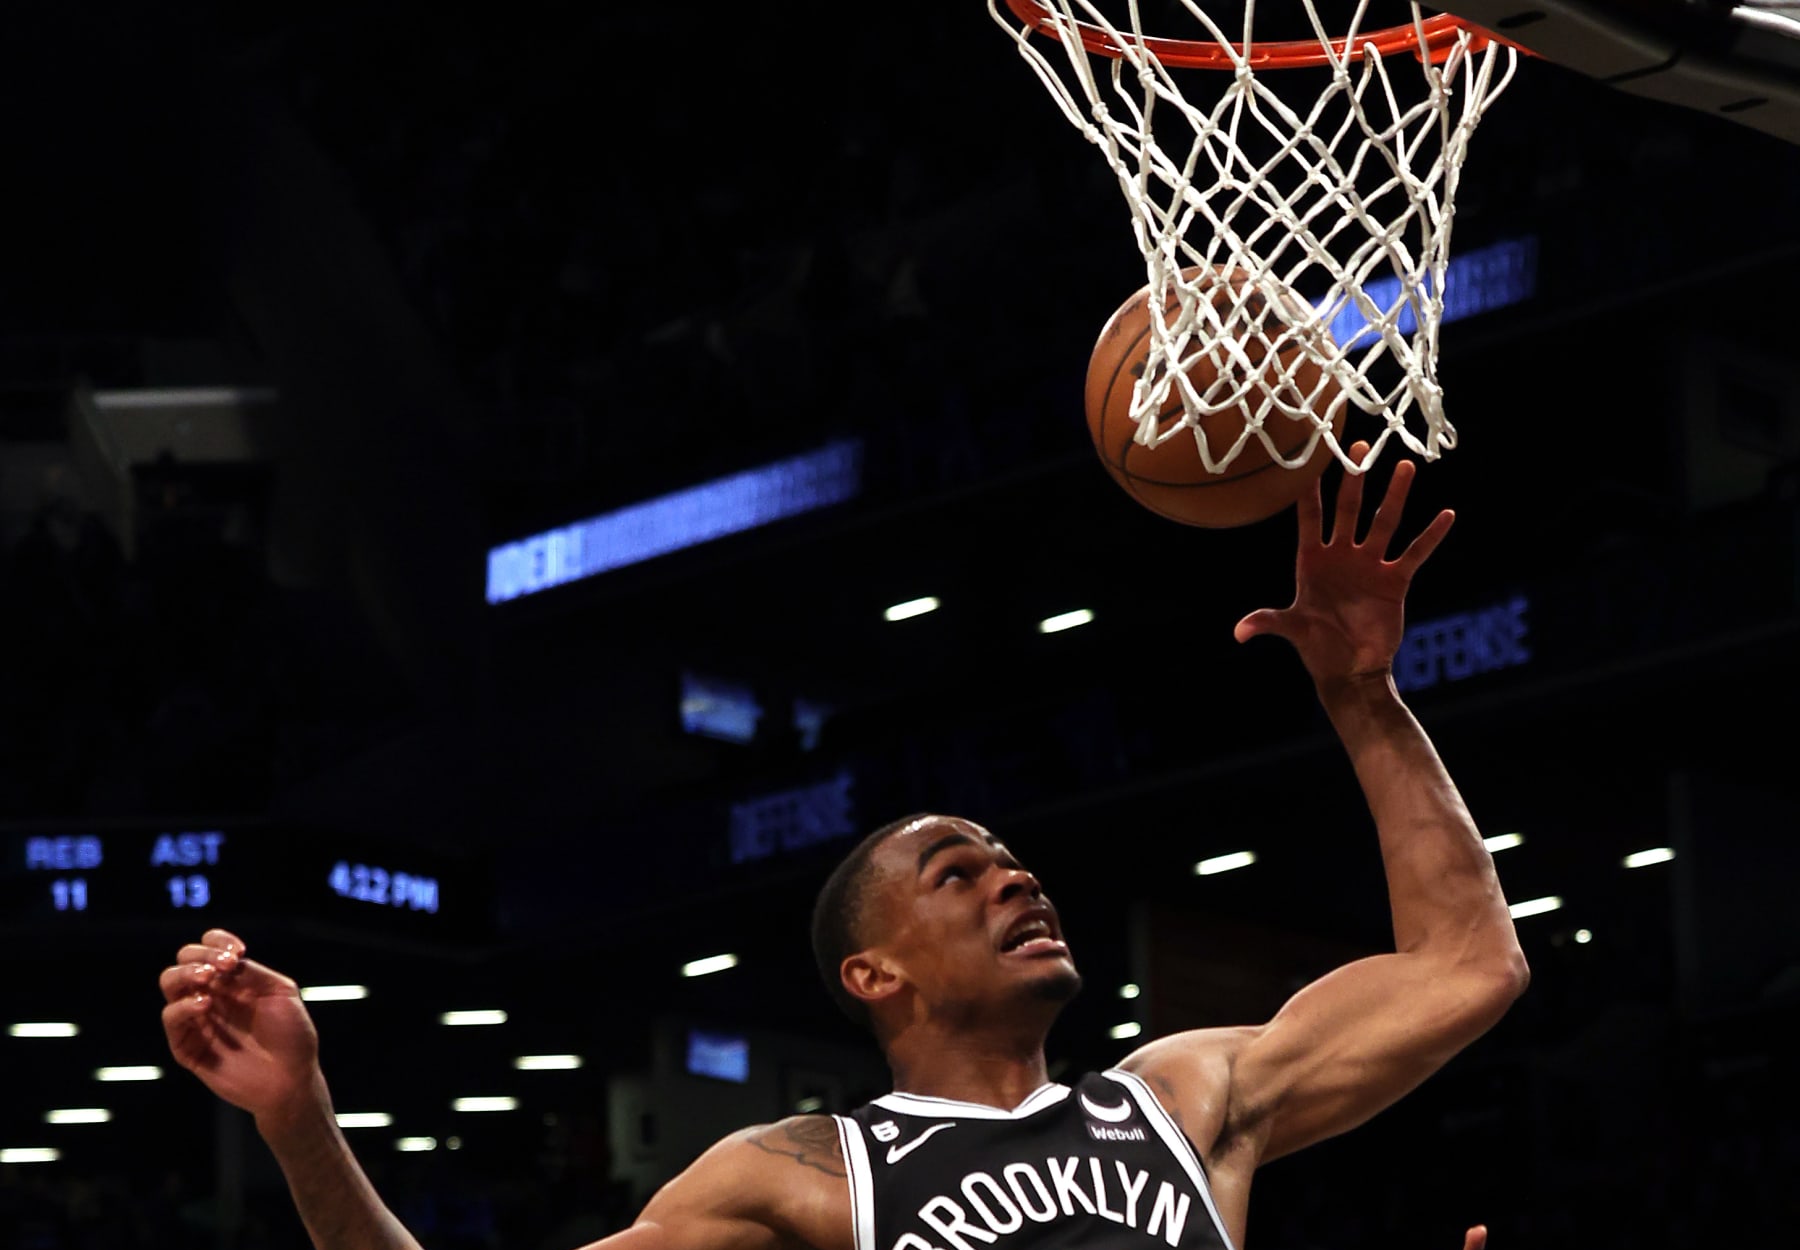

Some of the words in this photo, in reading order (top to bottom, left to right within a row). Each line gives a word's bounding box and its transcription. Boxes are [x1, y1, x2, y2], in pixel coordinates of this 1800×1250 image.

[26, 836, 103, 869] REB
[151, 832, 222, 866] AST
[51, 878, 88, 911] 11
[168, 874, 211, 908] 13
[1090, 1126, 1145, 1141] Webull
